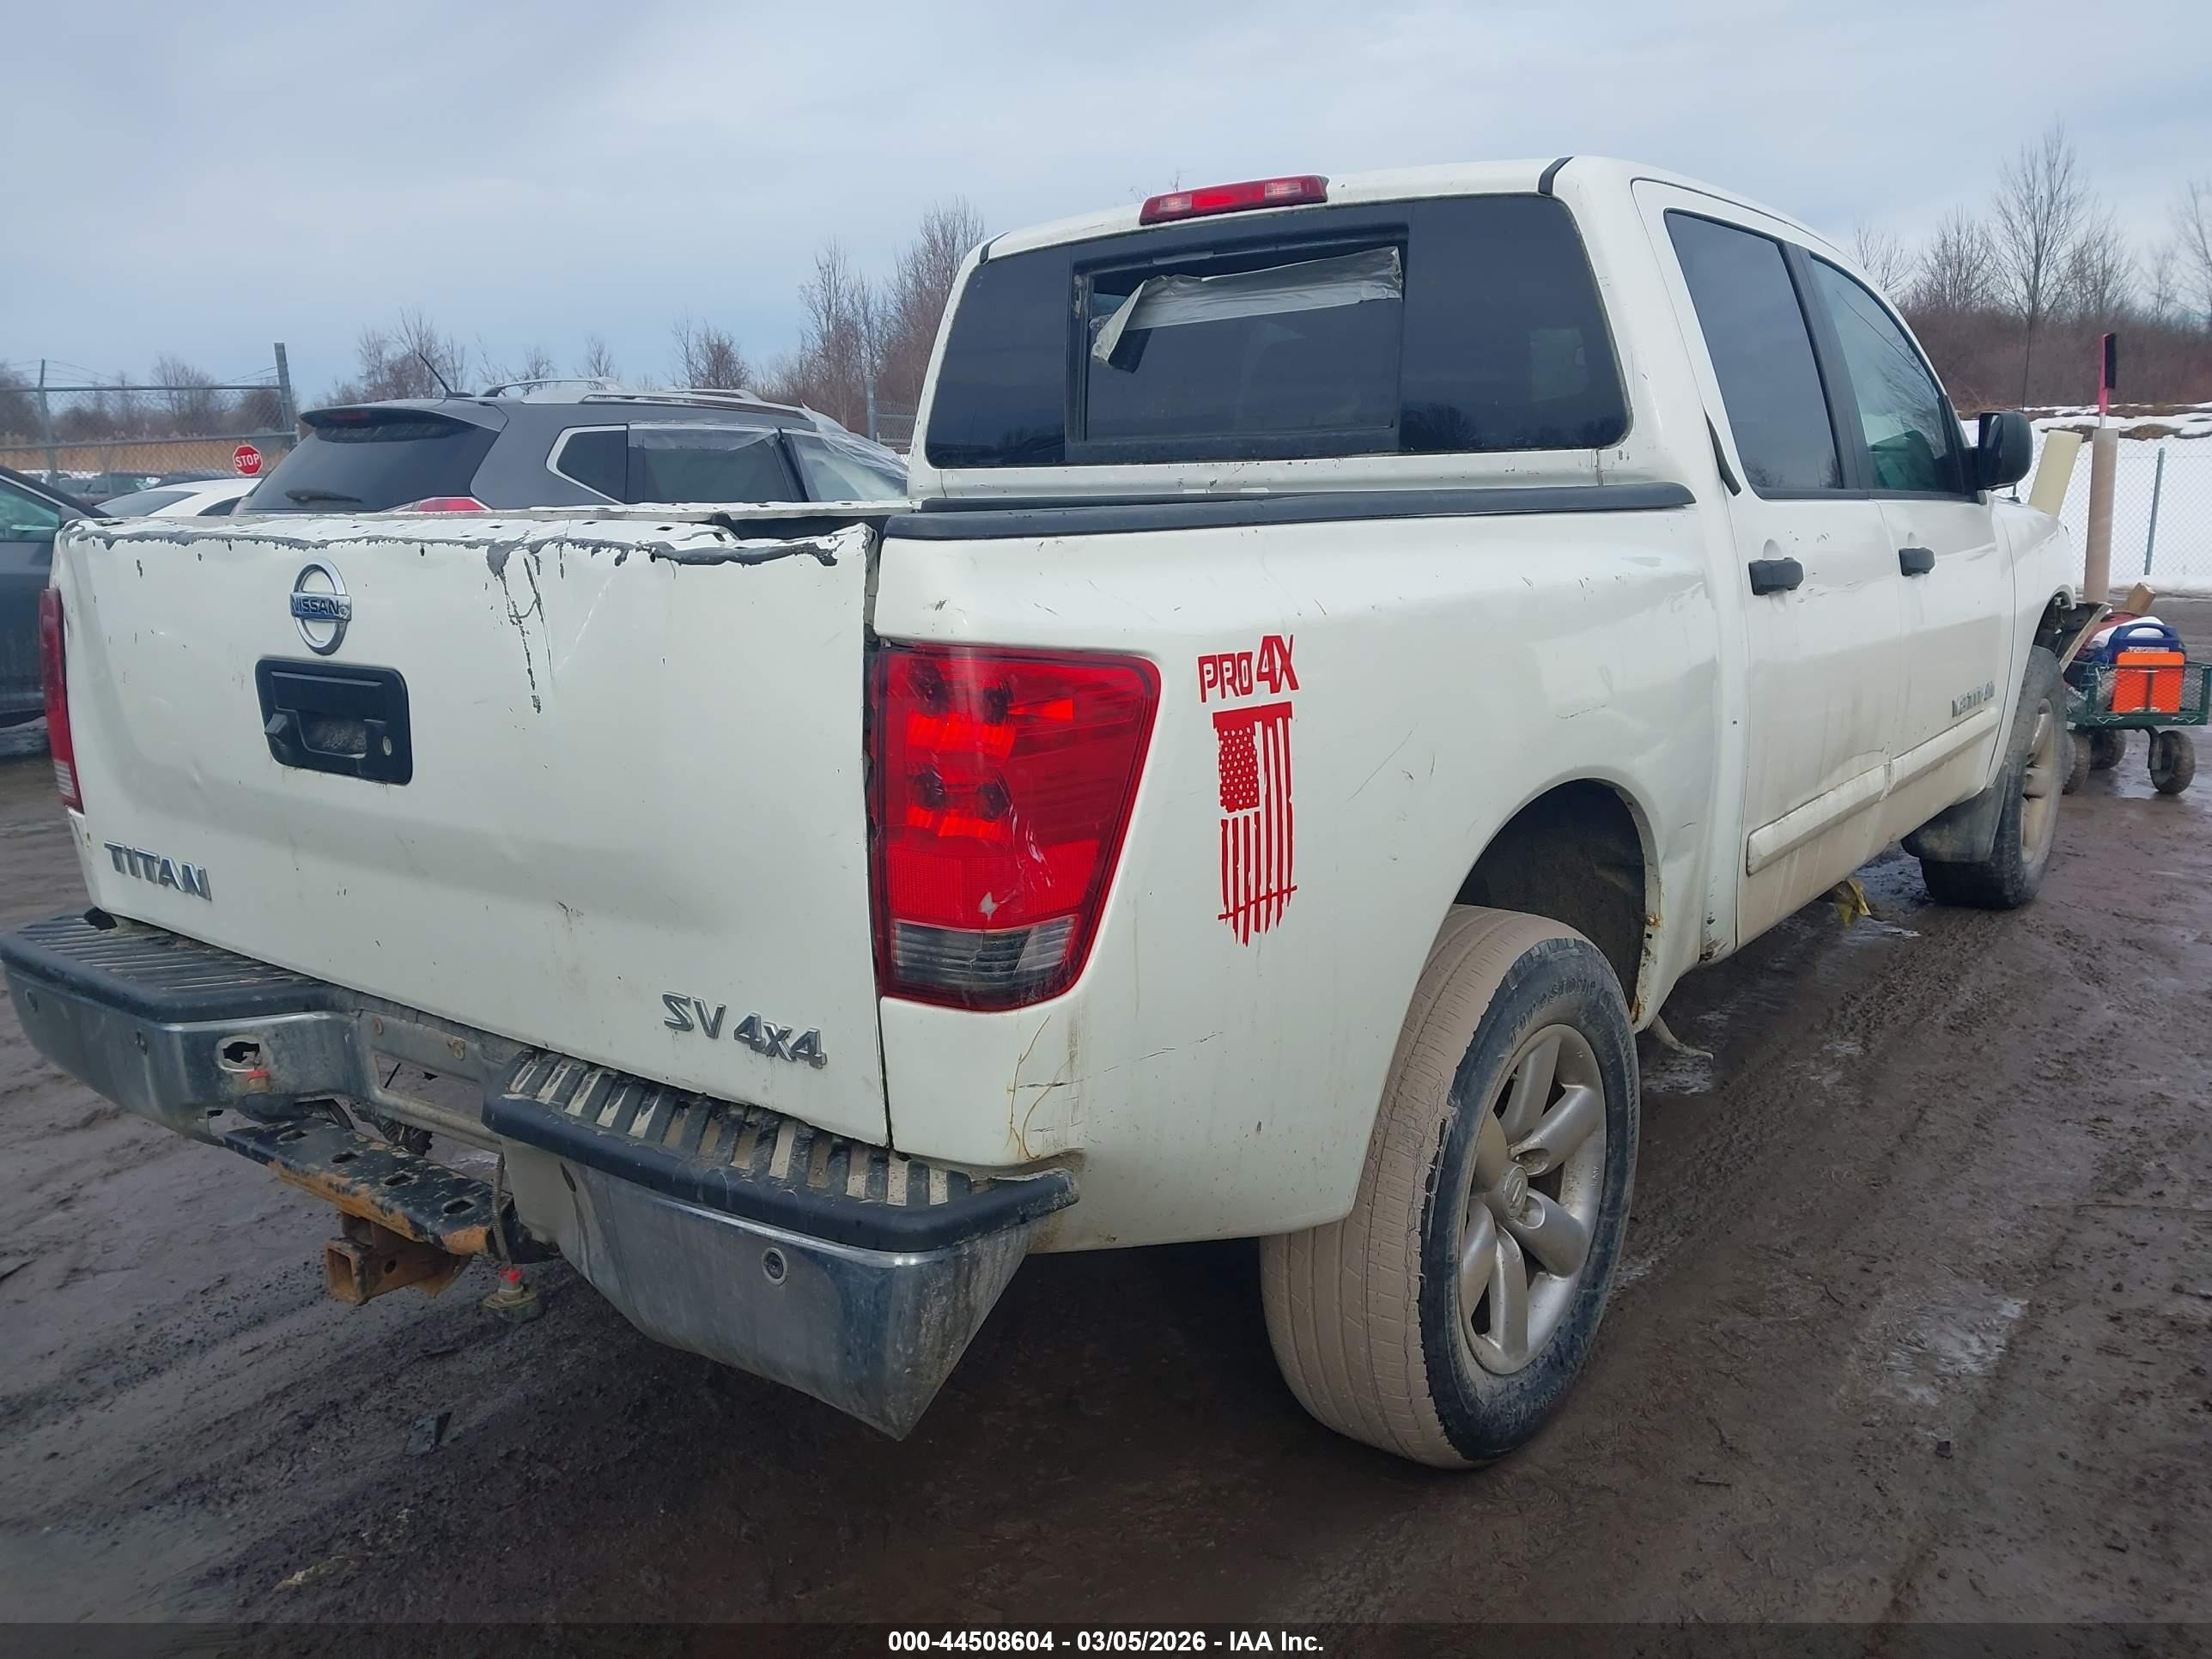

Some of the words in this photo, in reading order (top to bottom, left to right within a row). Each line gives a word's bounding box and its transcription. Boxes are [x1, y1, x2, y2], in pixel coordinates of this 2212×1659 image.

[235, 453, 259, 467] STOP
[291, 597, 339, 617] NISSAN
[104, 841, 212, 901] TITAN
[662, 991, 726, 1039] SV
